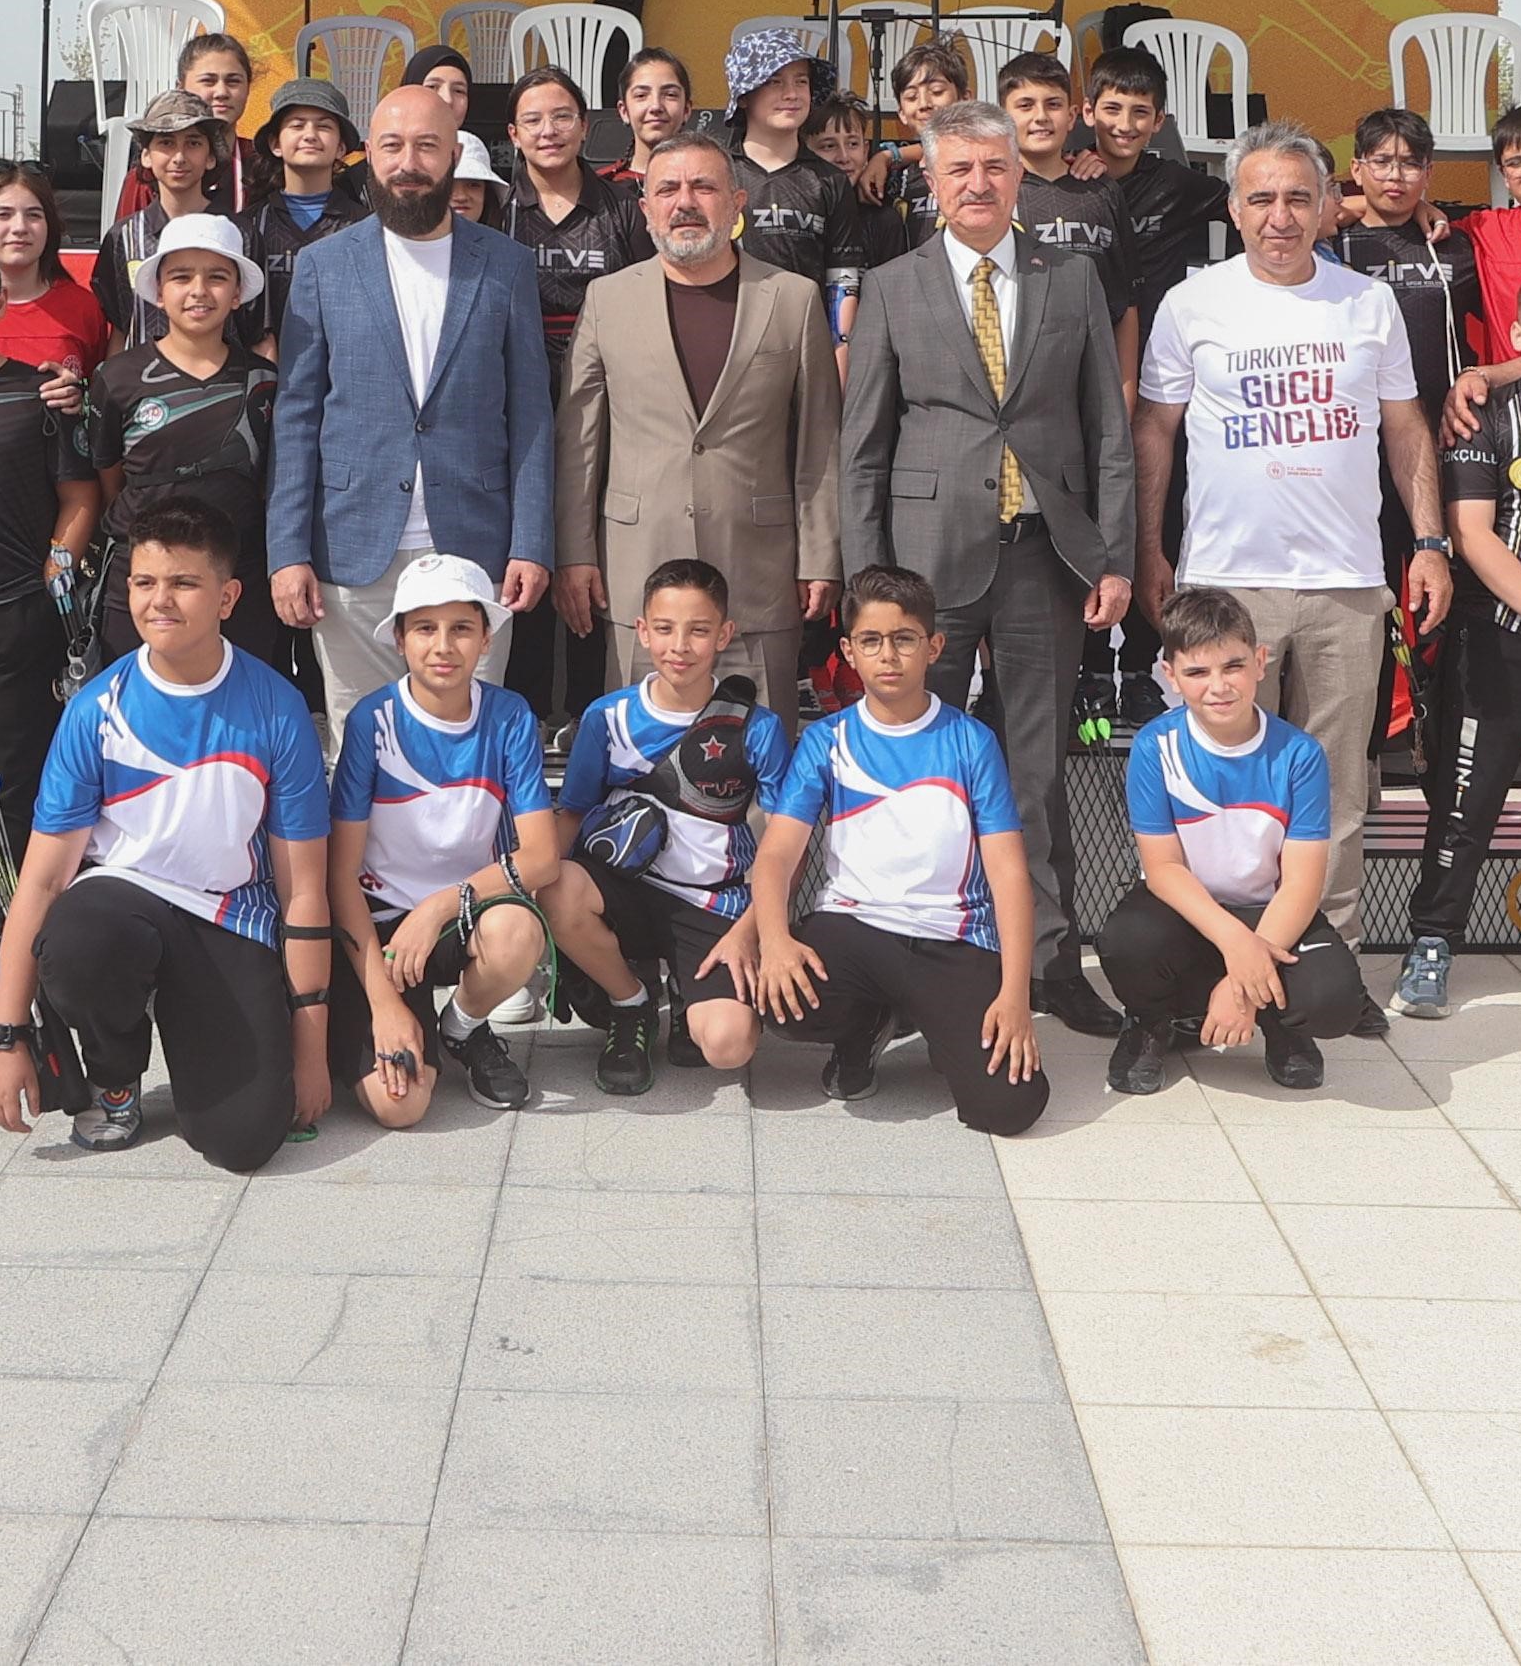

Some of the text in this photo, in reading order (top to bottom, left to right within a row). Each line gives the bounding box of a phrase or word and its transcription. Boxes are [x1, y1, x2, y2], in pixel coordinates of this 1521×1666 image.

[1225, 341, 1346, 373] TÜRKİYE'NİN
[1240, 368, 1334, 409] GÜCÜ
[1222, 403, 1360, 450] GENÇLİĞİ
